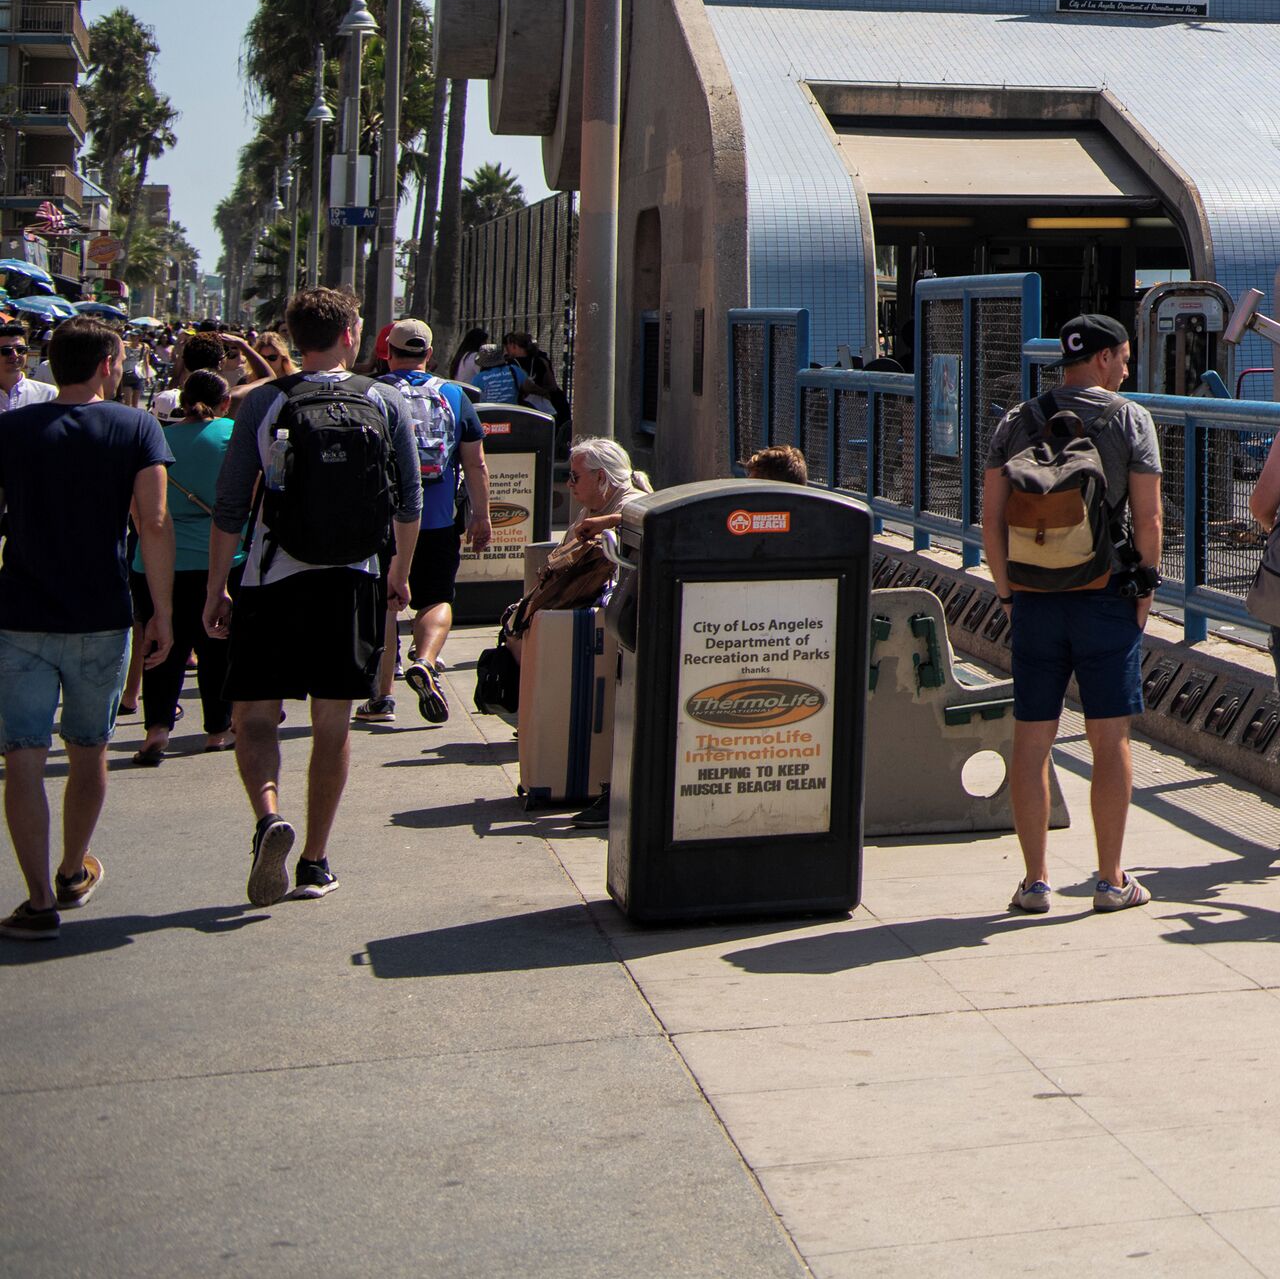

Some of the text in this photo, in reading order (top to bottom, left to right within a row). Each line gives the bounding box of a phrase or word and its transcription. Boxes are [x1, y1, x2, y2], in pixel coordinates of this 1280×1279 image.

[363, 208, 376, 219] Av
[1068, 333, 1084, 351] C
[752, 521, 787, 529] BEACH
[693, 618, 823, 635] City of Los Angeles
[705, 634, 811, 651] Department of
[684, 649, 830, 665] Recreation and Parks
[741, 666, 770, 674] thanks
[692, 693, 820, 711] ThermoLife
[695, 730, 812, 748] ThermoLife
[685, 744, 821, 763] International
[698, 763, 810, 780] HELPING TO KEEP
[680, 777, 826, 797] MUSCLE BEACH CLEAN
